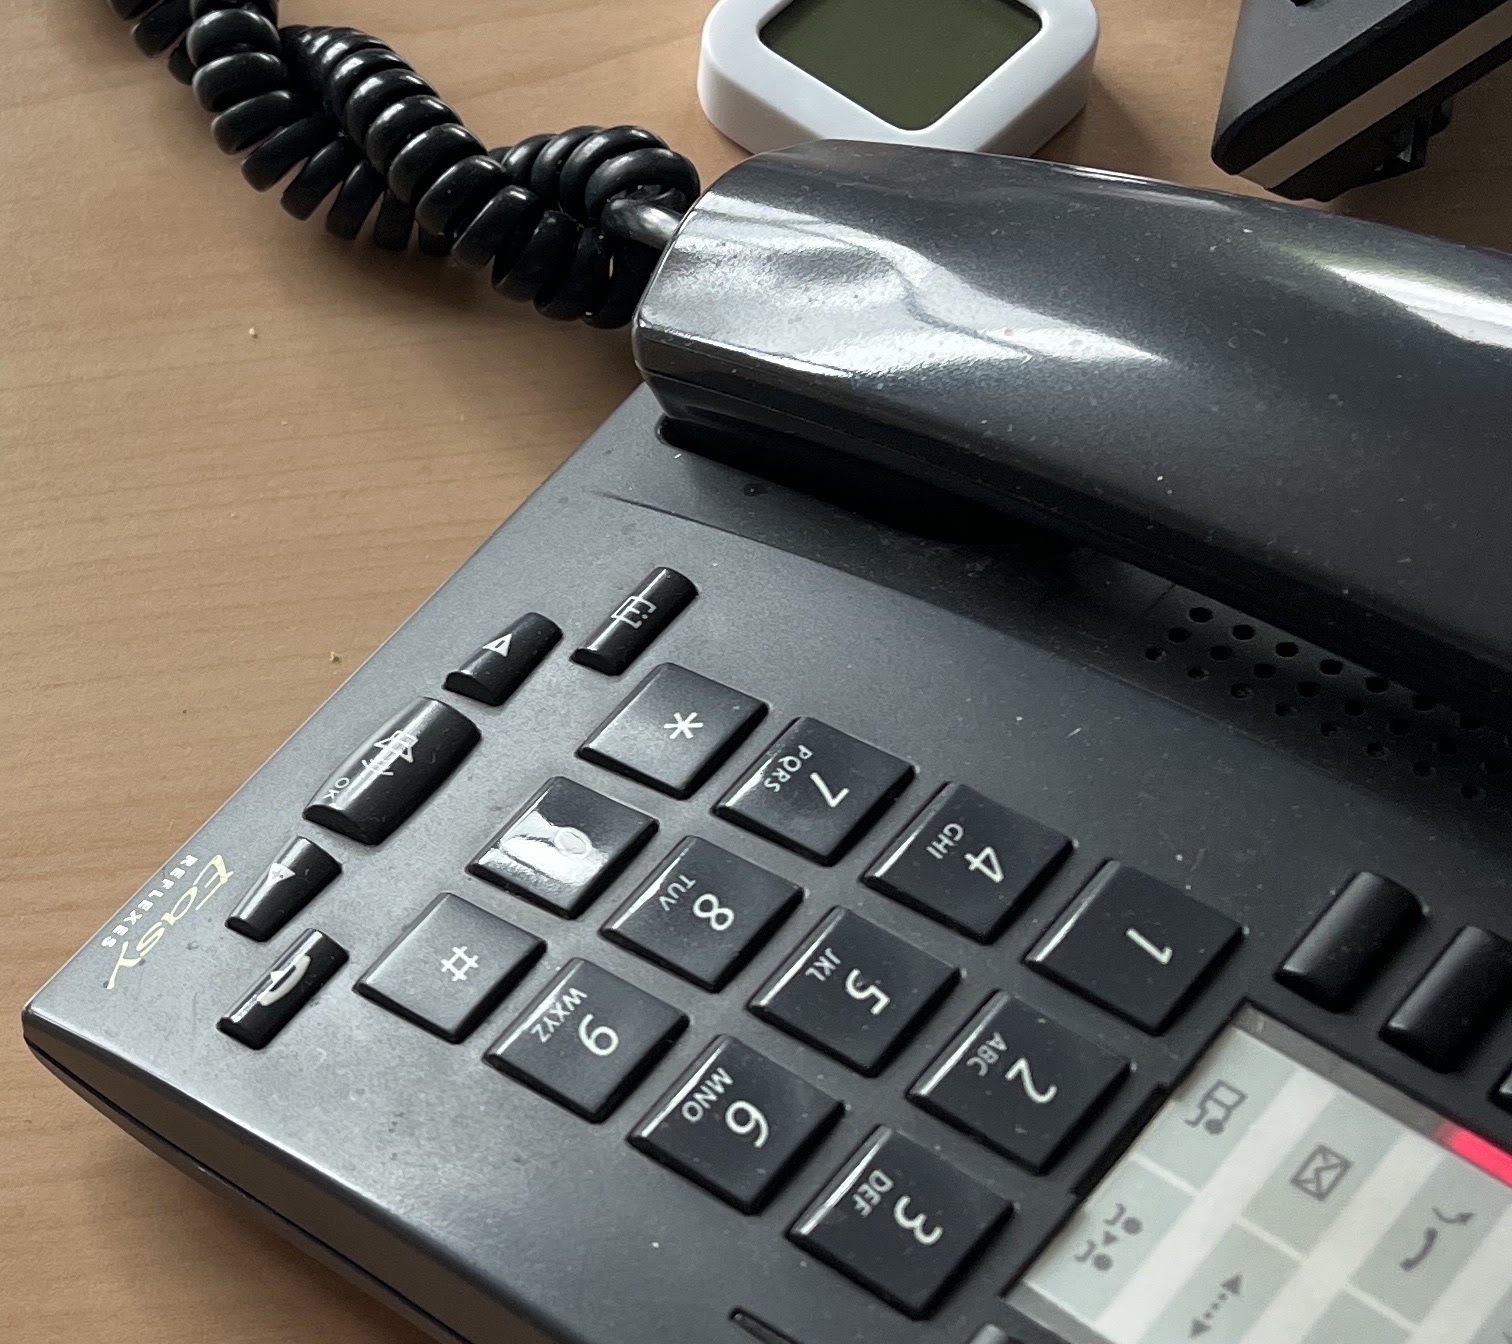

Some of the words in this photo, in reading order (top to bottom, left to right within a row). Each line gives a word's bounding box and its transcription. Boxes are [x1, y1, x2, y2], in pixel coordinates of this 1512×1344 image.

[323, 777, 350, 799] OK
[764, 744, 813, 793] PQRS
[809, 772, 850, 807] 7
[925, 822, 964, 860] GHI
[963, 846, 1004, 884] 4
[101, 854, 199, 948] REFLEXES
[658, 874, 697, 912] TUV
[693, 893, 735, 931] 8
[106, 854, 234, 990] Easy
[805, 947, 842, 982] JKL
[1125, 927, 1173, 965] 1
[845, 968, 891, 1016] 5
[530, 987, 587, 1044] WXYZ
[578, 1013, 619, 1056] 9
[966, 1031, 1008, 1077] ABC
[681, 1067, 734, 1123] MNO
[1004, 1057, 1058, 1103] 2
[725, 1100, 769, 1148] 6
[852, 1169, 895, 1218] DEF
[893, 1195, 943, 1245] 3
